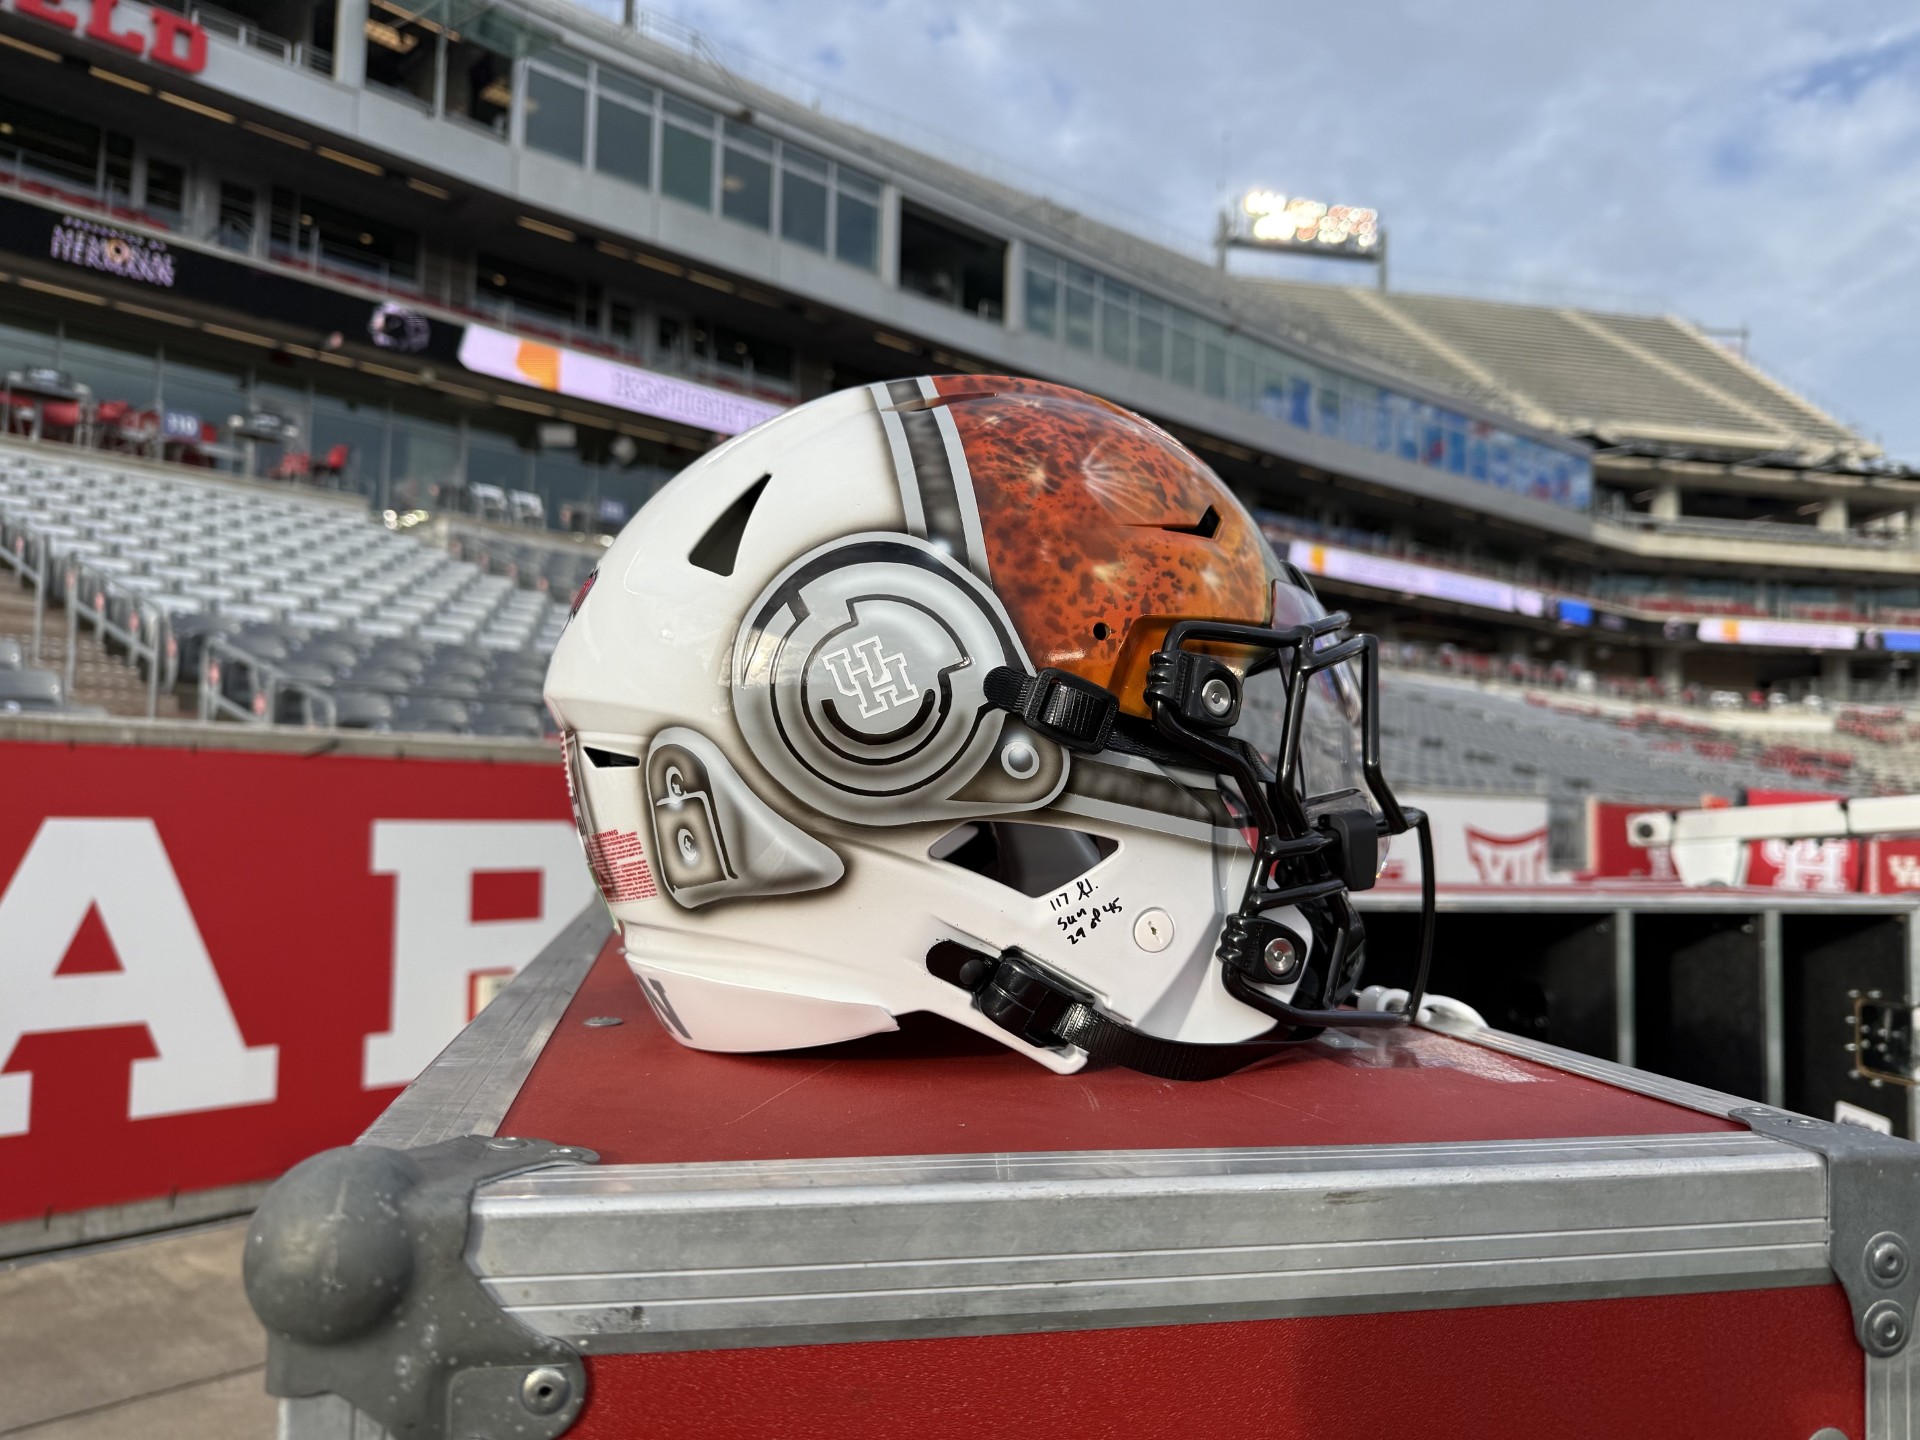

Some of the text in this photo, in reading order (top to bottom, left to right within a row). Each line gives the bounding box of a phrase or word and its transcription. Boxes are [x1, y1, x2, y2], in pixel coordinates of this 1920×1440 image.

[821, 636, 920, 719] UH
[1049, 892, 1069, 911] 117
[1102, 897, 1123, 914] 45
